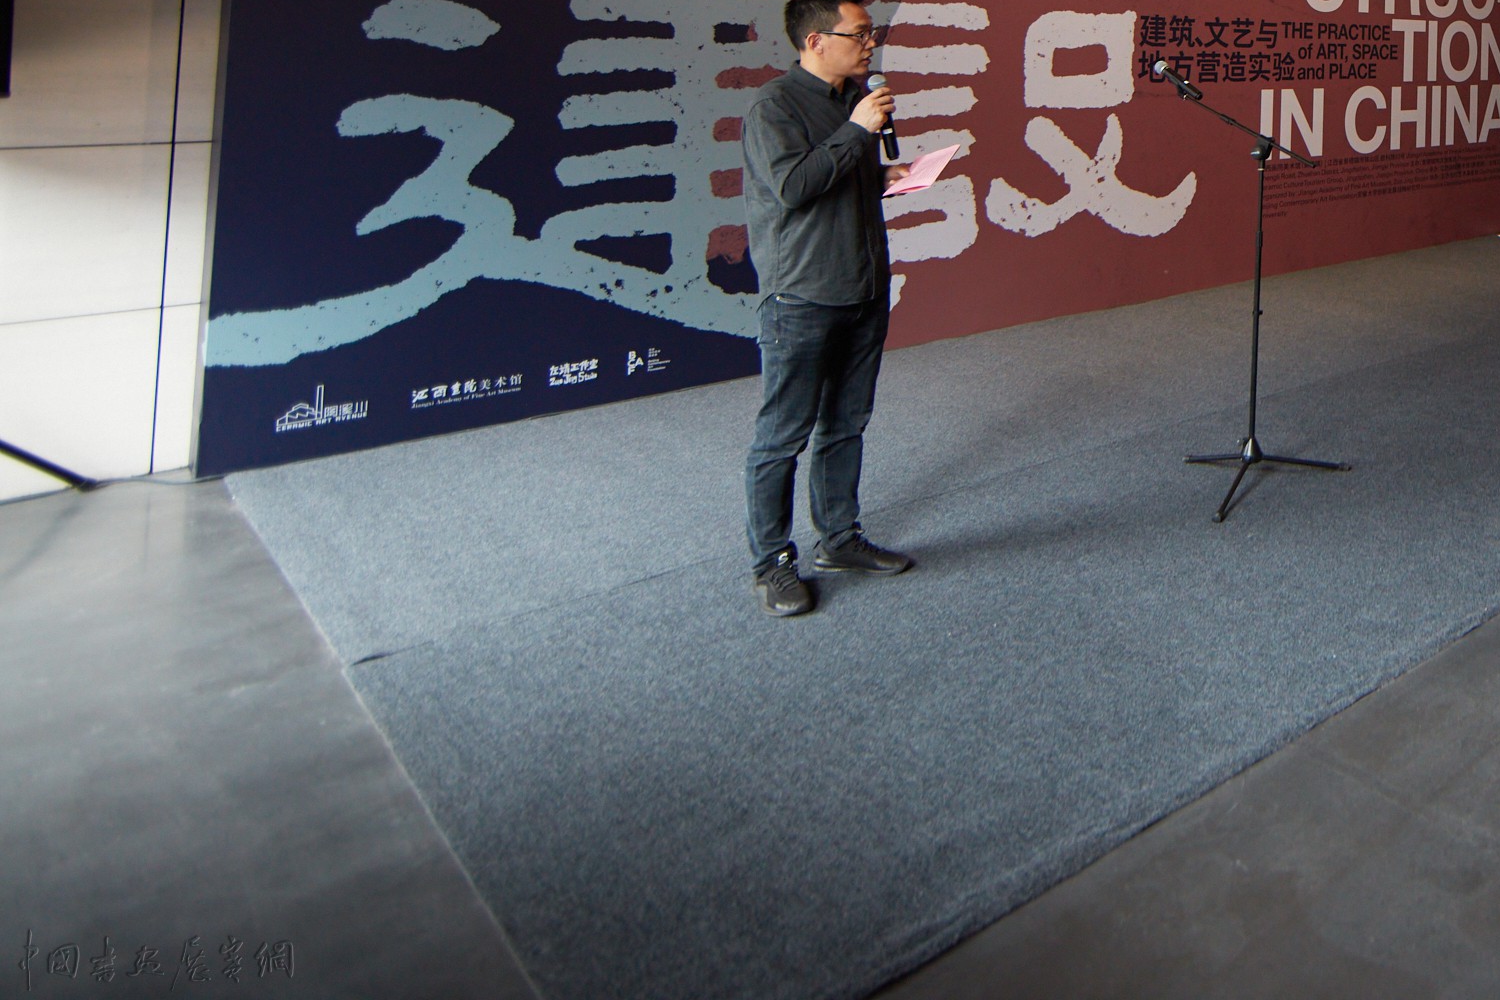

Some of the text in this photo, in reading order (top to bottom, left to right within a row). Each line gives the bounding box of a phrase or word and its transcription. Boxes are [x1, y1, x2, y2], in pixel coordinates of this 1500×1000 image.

[1139, 14, 1278, 50] 建筑、文艺与
[1281, 21, 1391, 42] THE PRACTICE
[1298, 43, 1399, 63] of ART, SPACE
[1138, 50, 1295, 84] 地方营造实验
[1297, 63, 1377, 81] and PLACE
[1260, 87, 1324, 161] IN
[436, 396, 462, 406] Academy
[470, 392, 485, 400] Fine
[486, 389, 496, 397] Art
[497, 386, 522, 395] Museum
[276, 411, 368, 433] CERAMIC ART AVENUE
